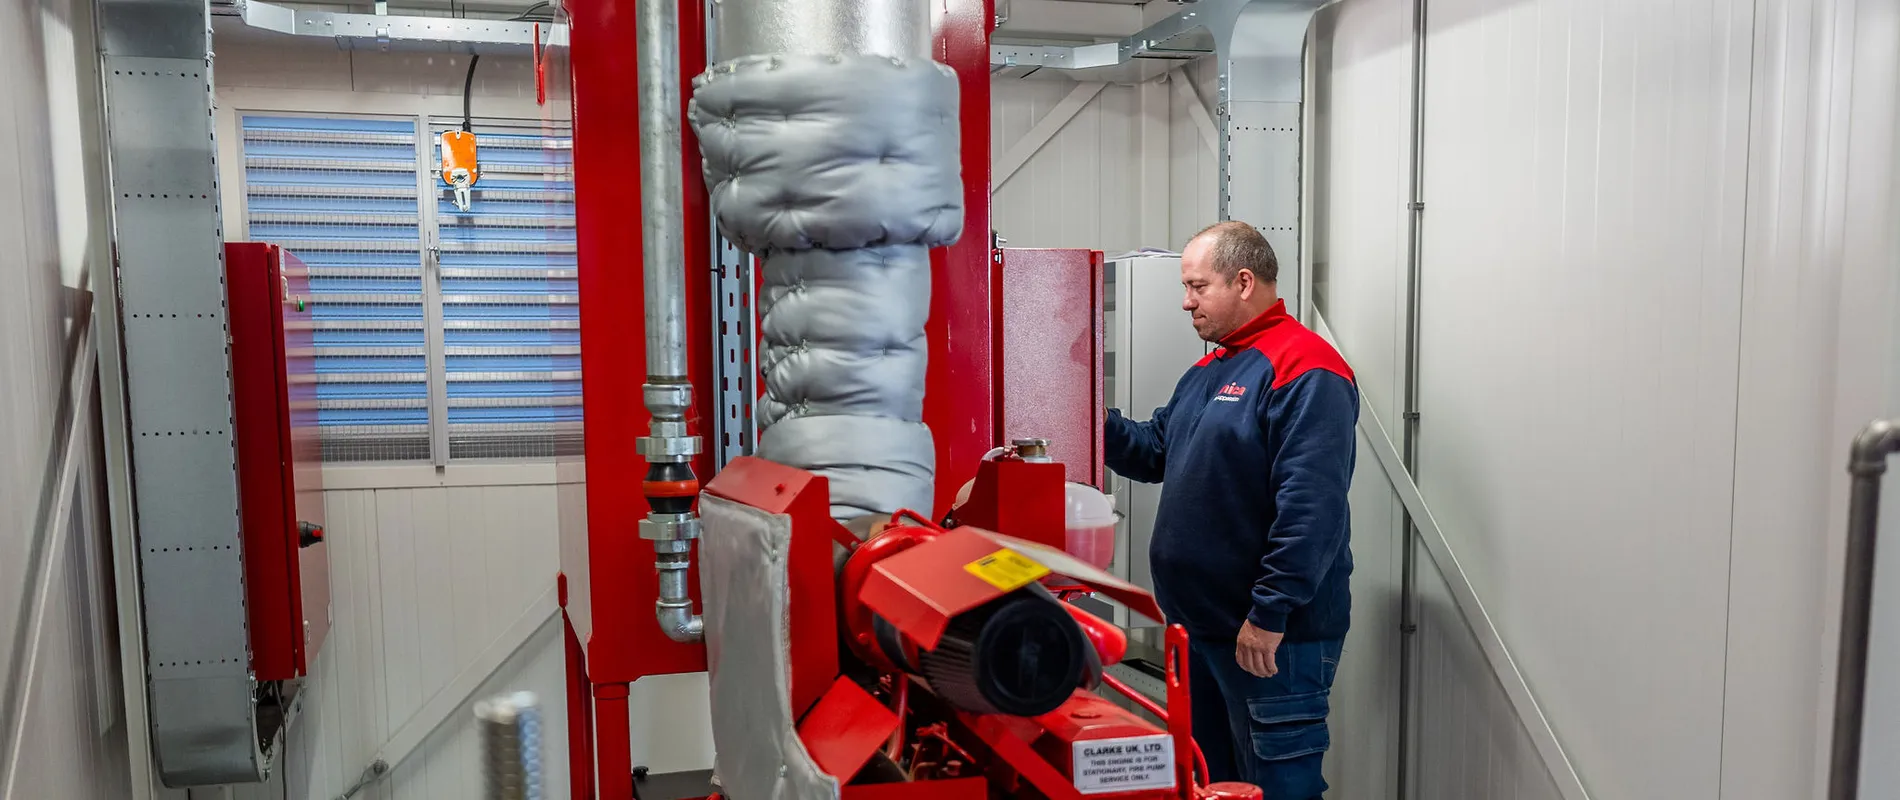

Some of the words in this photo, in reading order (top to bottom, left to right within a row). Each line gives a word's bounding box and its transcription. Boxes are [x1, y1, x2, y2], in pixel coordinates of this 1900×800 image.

[1083, 746, 1122, 757] CLARKE
[1144, 743, 1163, 752] LTD.
[1108, 757, 1133, 766] ENGINE
[1129, 765, 1144, 773] FIRE
[1146, 763, 1166, 771] PUMP
[1101, 775, 1129, 783] SERVICE
